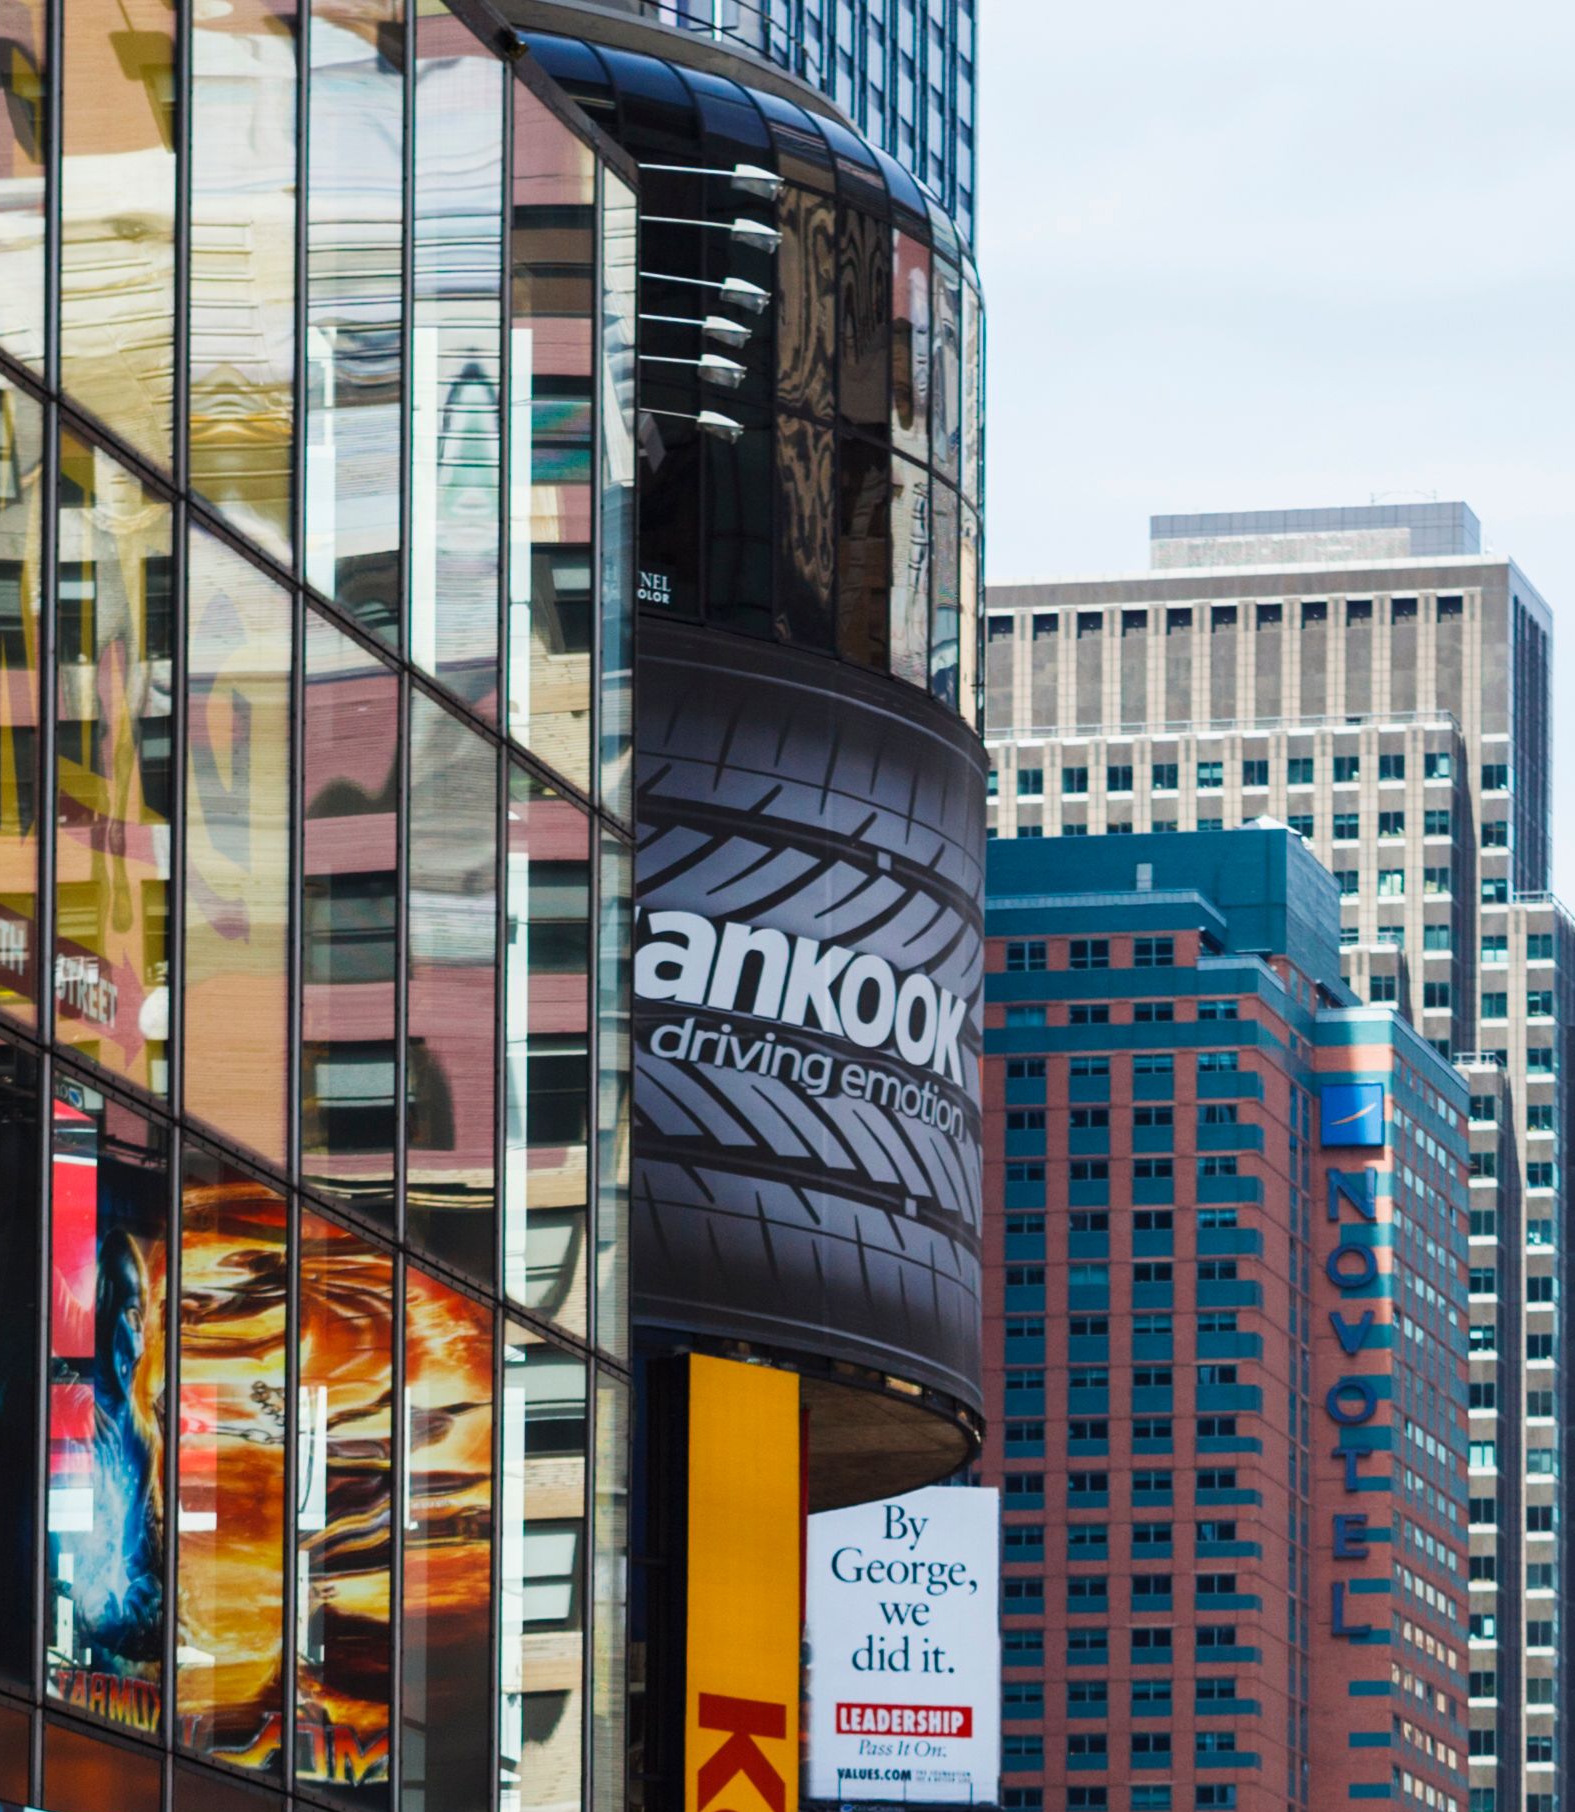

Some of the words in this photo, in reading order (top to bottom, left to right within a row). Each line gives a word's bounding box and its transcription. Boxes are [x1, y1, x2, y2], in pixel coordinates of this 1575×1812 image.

[633, 905, 968, 1089] ankook
[650, 1017, 833, 1096] driving
[840, 1062, 966, 1143] emotion
[1327, 1165, 1378, 1638] NOVOTEL
[882, 1503, 930, 1551] By
[830, 1545, 978, 1597] George,
[878, 1599, 931, 1628] we
[851, 1634, 911, 1675] did
[919, 1636, 956, 1675] it.
[838, 1705, 965, 1736] LEADERSHIP
[857, 1738, 892, 1758] Pass
[894, 1738, 911, 1758] It
[837, 1767, 913, 1783] VALUES.COM
